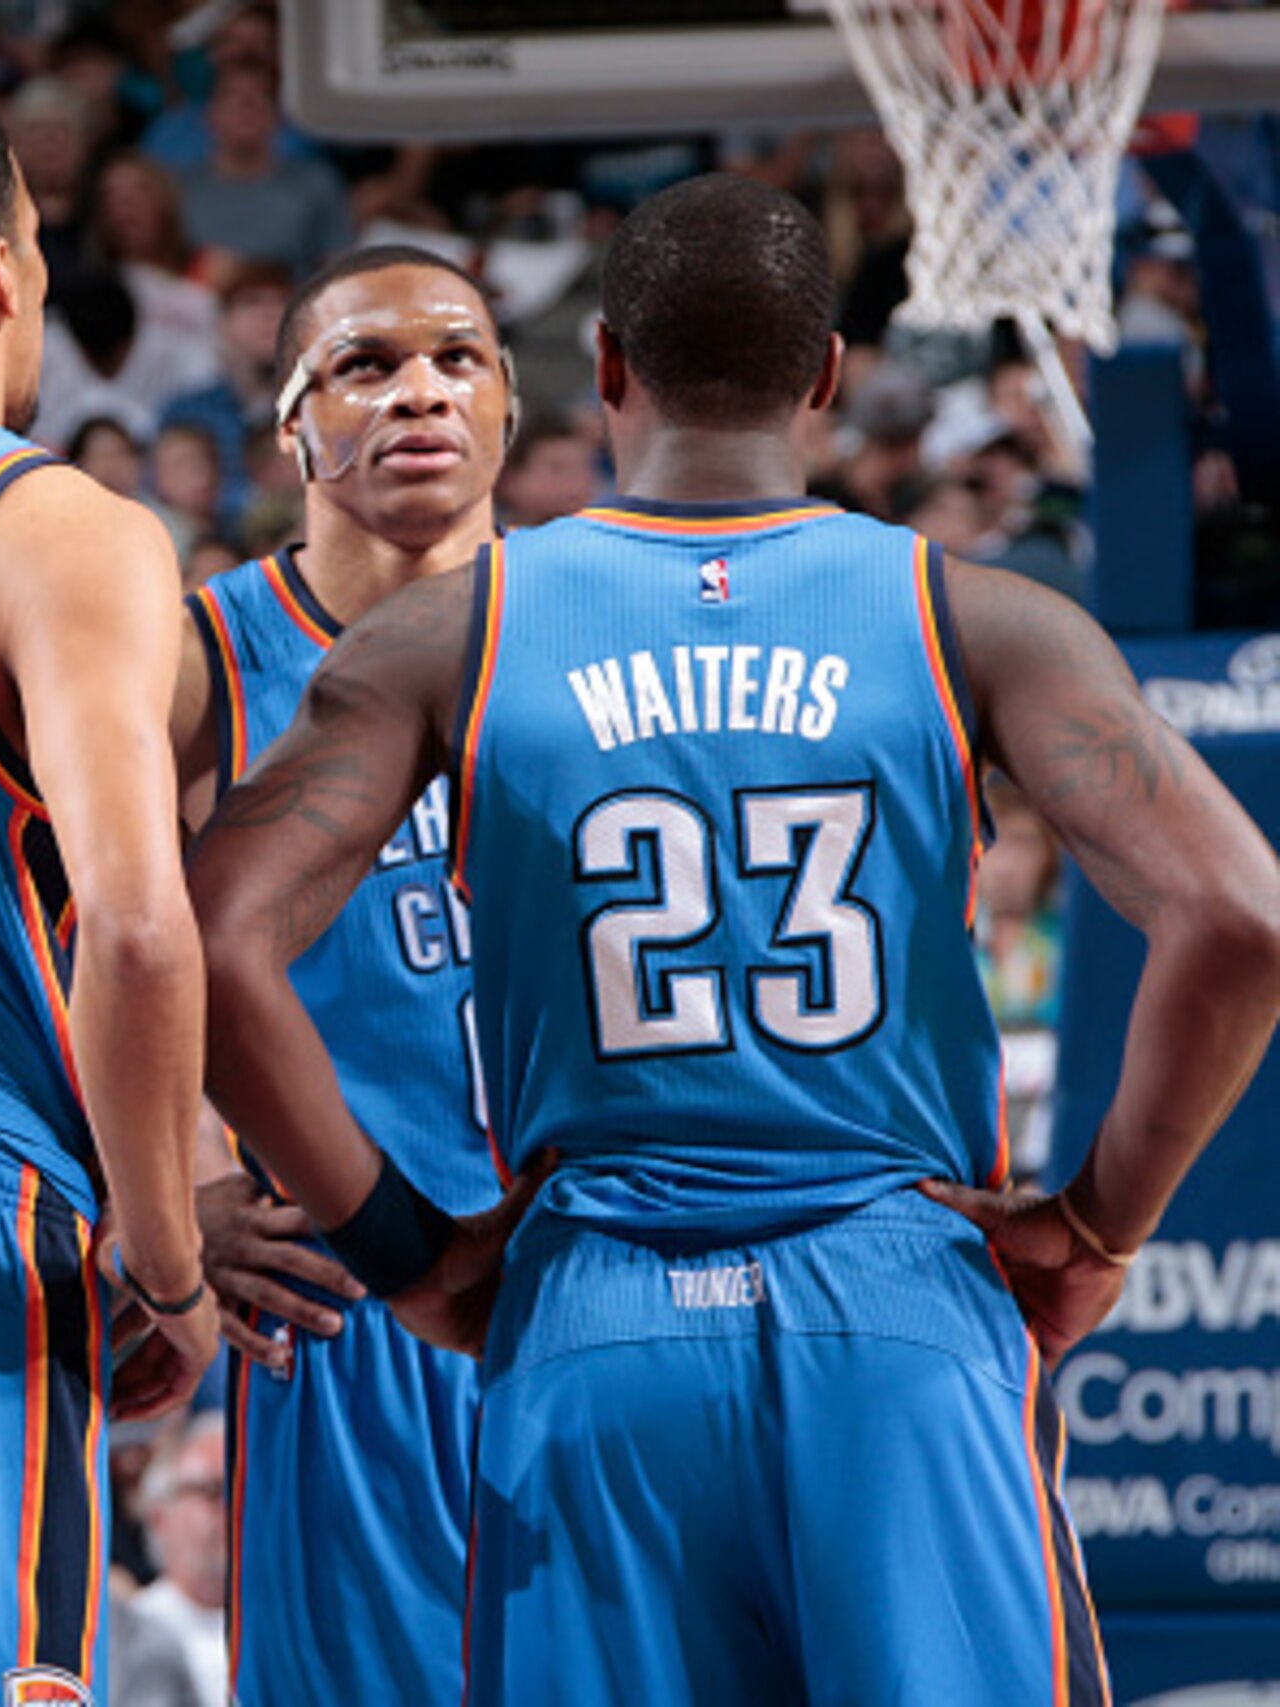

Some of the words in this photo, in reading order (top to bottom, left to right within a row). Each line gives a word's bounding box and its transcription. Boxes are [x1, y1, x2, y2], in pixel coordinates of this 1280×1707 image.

[567, 644, 850, 752] WAITERS
[571, 779, 889, 1064] 23
[1055, 1351, 1280, 1446] Com
